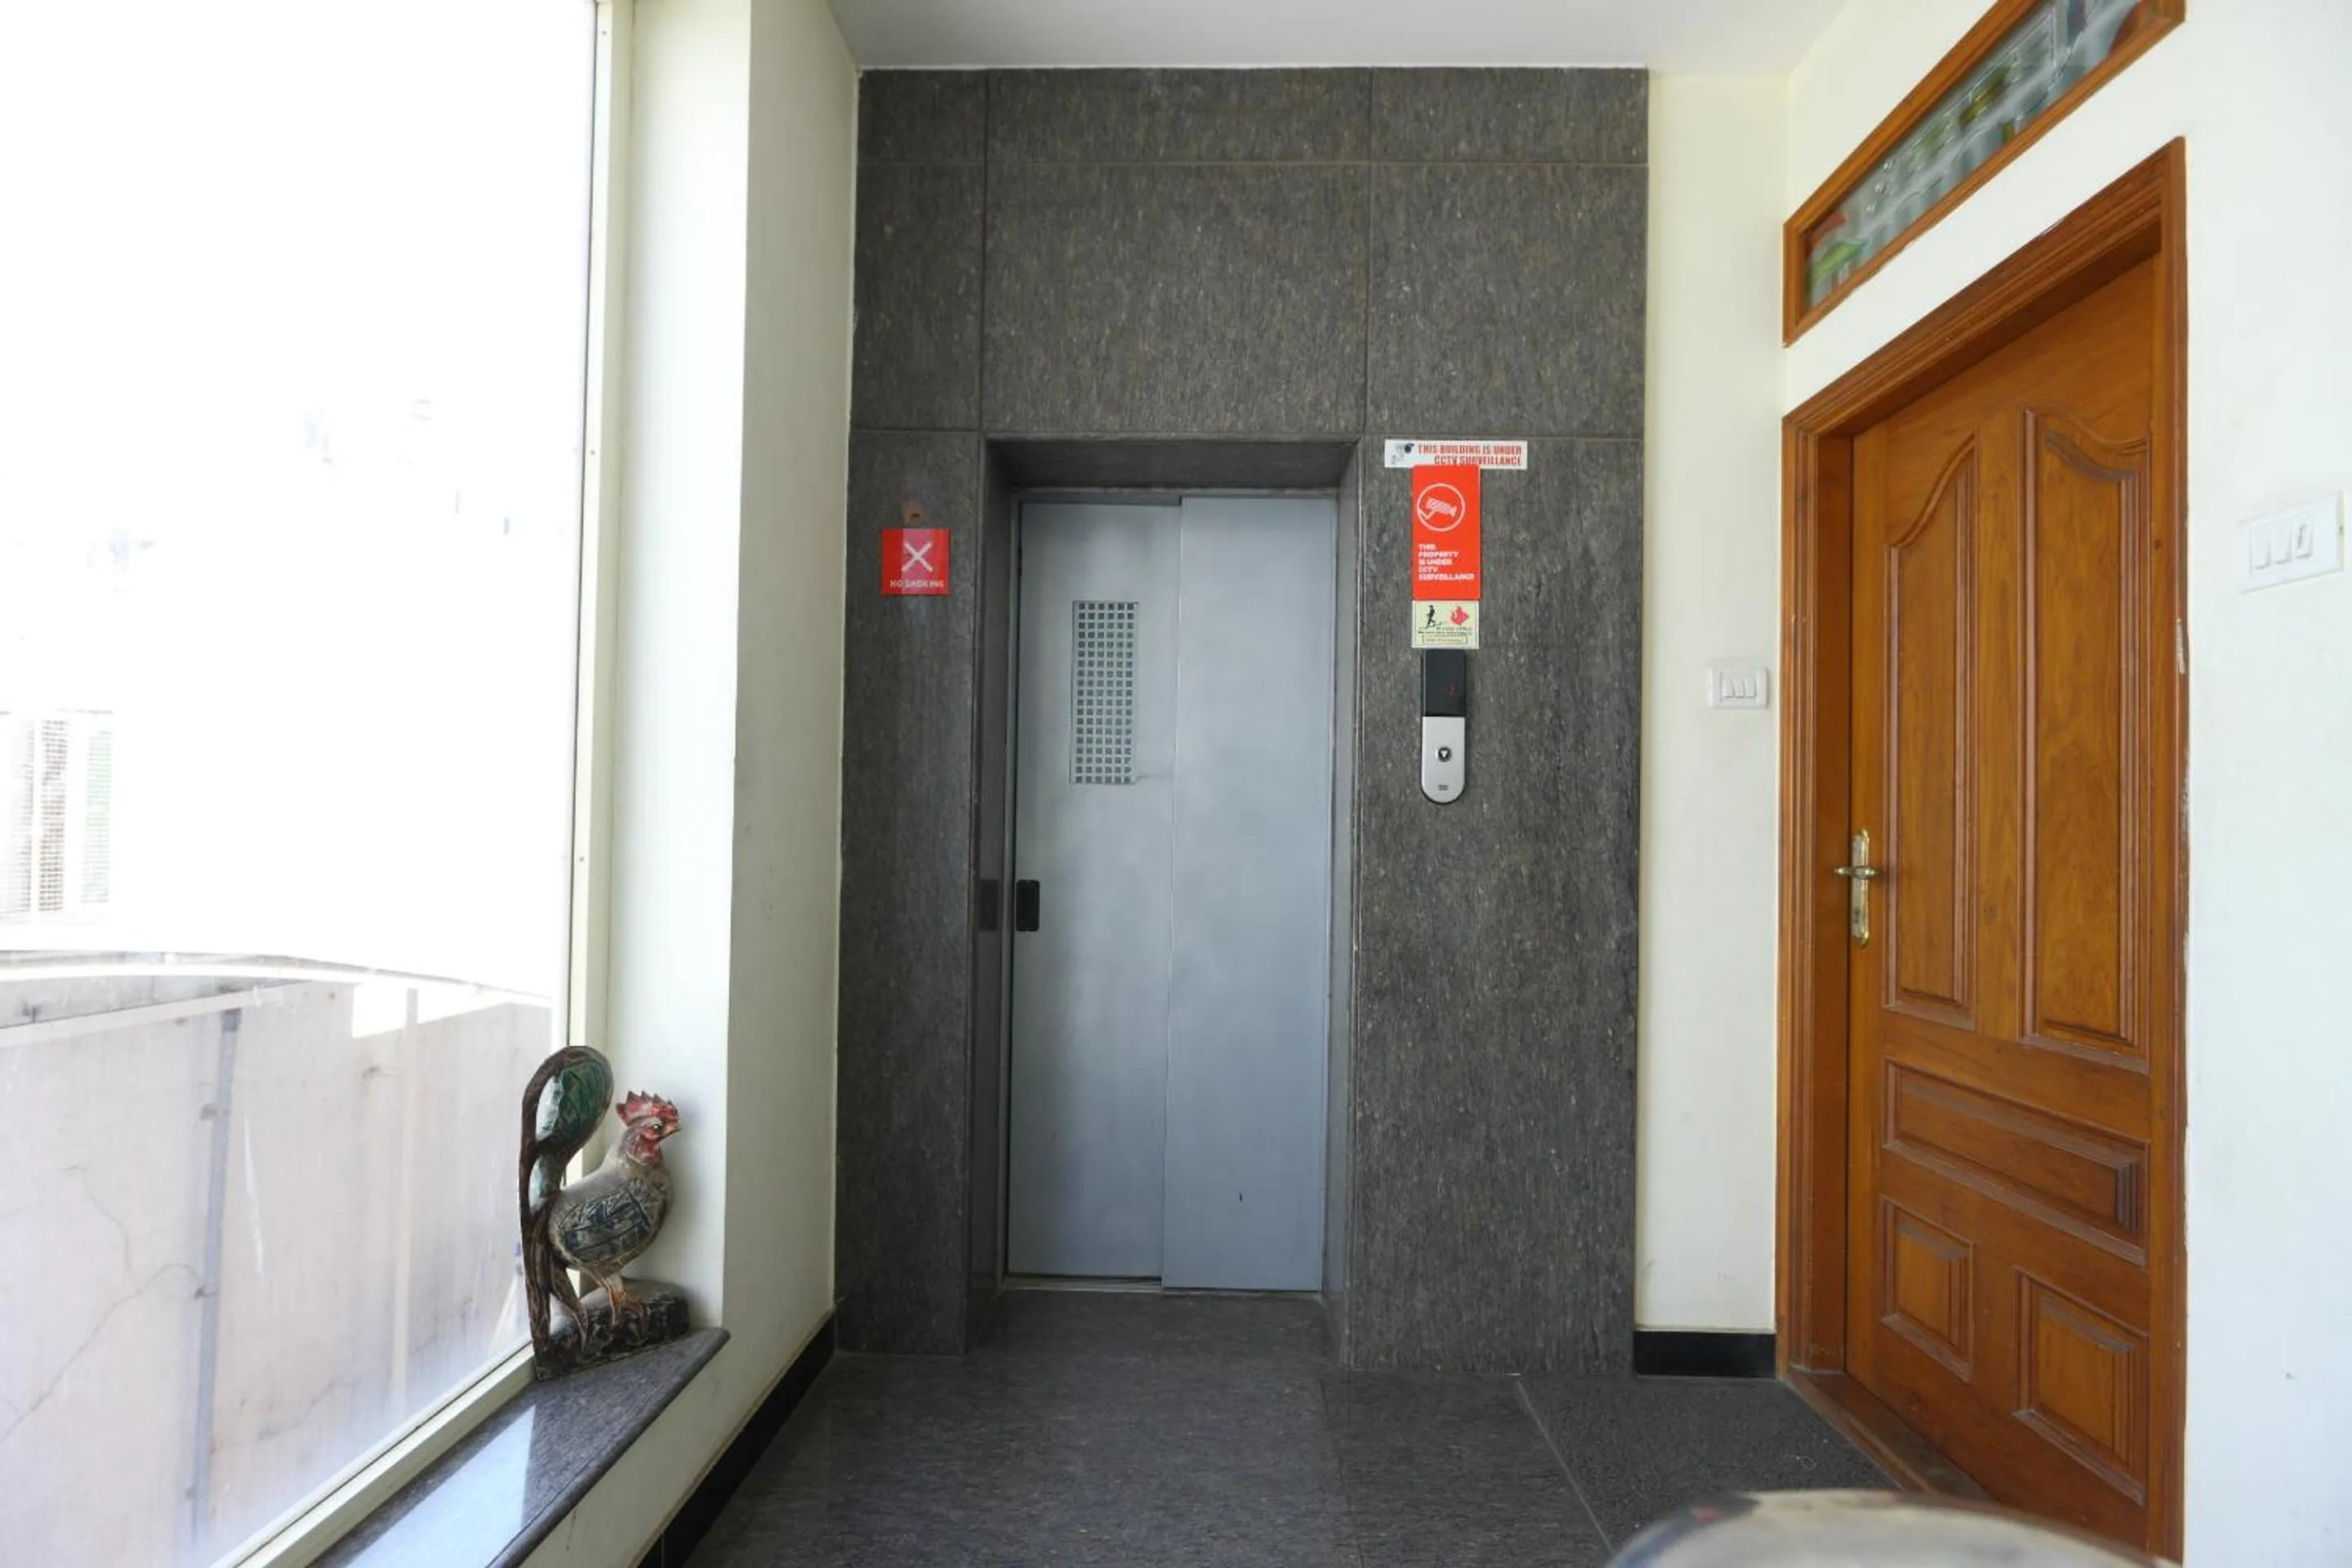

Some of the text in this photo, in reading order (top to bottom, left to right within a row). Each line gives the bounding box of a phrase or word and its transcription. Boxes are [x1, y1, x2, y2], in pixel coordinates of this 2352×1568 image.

[1418, 444, 1521, 454] THIS BUILDING IS UNDER
[1434, 456, 1521, 466] CCTV SURVEILLANCE
[1418, 572, 1475, 581] SURVEILLANCE
[889, 580, 945, 588] NO SMOKING
